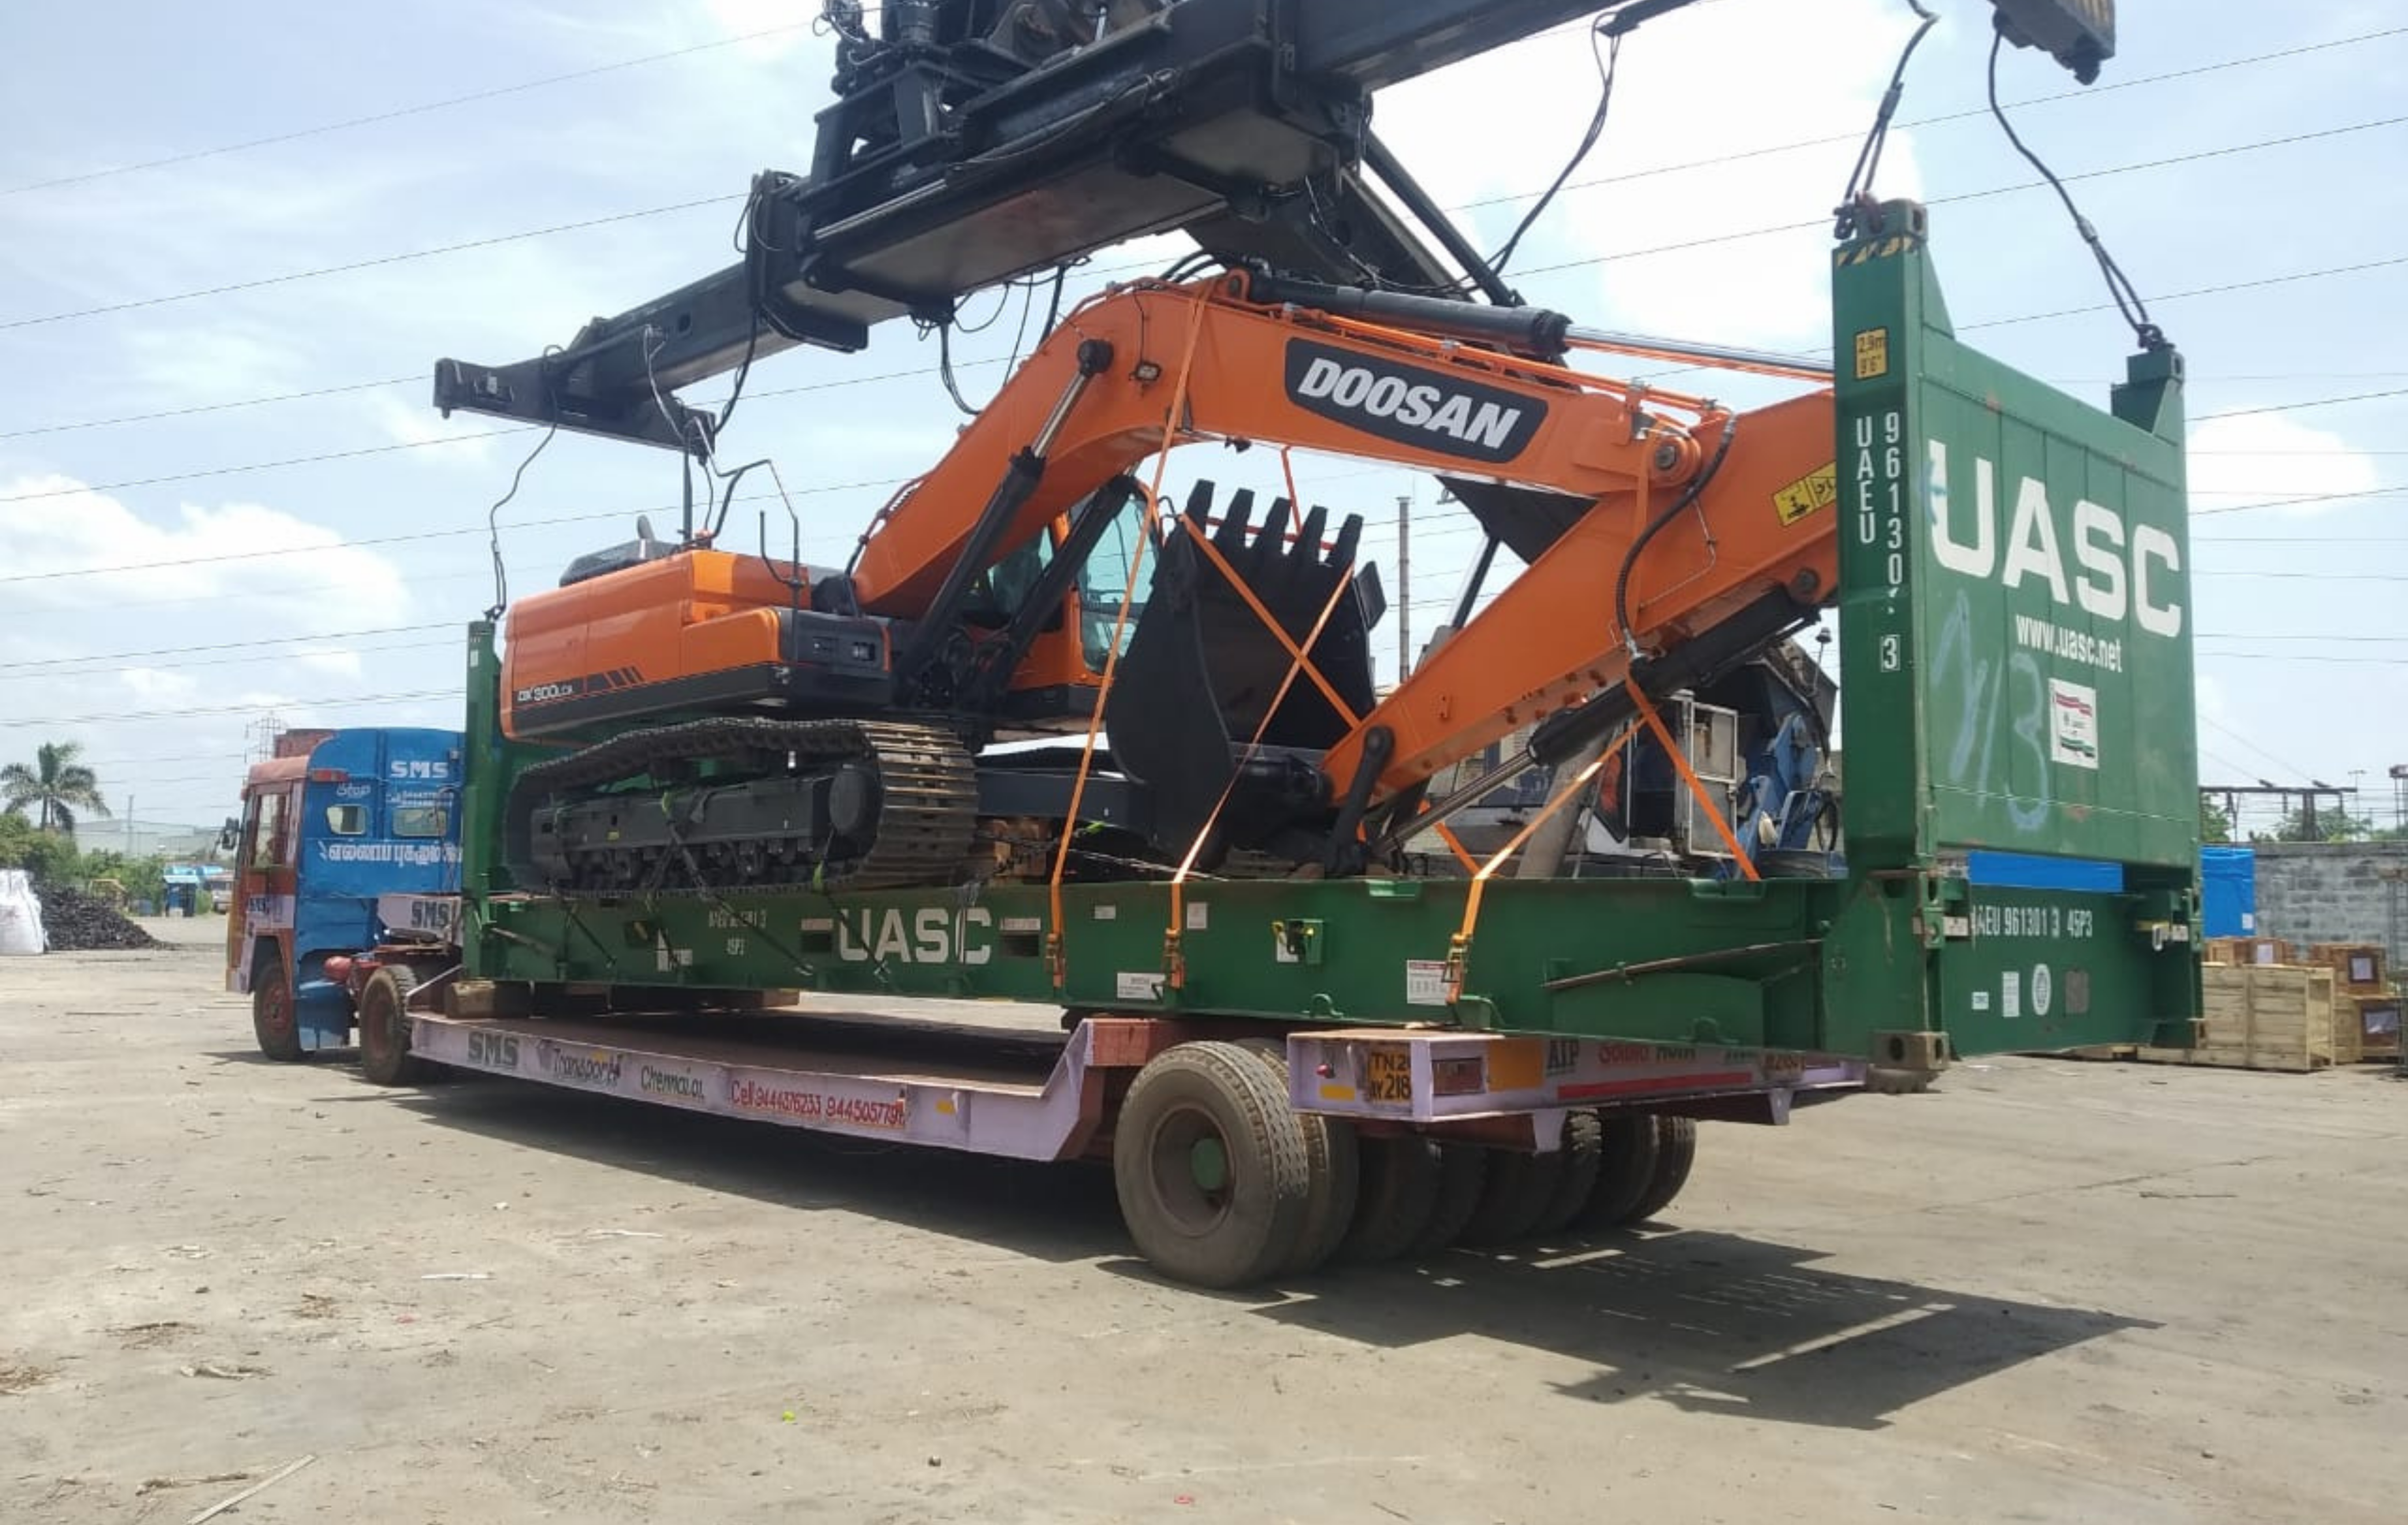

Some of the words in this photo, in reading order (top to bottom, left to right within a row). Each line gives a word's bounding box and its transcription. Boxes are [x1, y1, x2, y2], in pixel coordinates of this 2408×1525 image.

[1298, 358, 1520, 449] DOOSAN
[1856, 417, 1875, 543] UAEU
[1929, 440, 2181, 638] UASC
[2016, 614, 2122, 673] www.uasc.net
[390, 761, 448, 778] SMS
[411, 901, 449, 927] SMS
[838, 908, 991, 964] UASC
[468, 1030, 518, 1069] SMS
